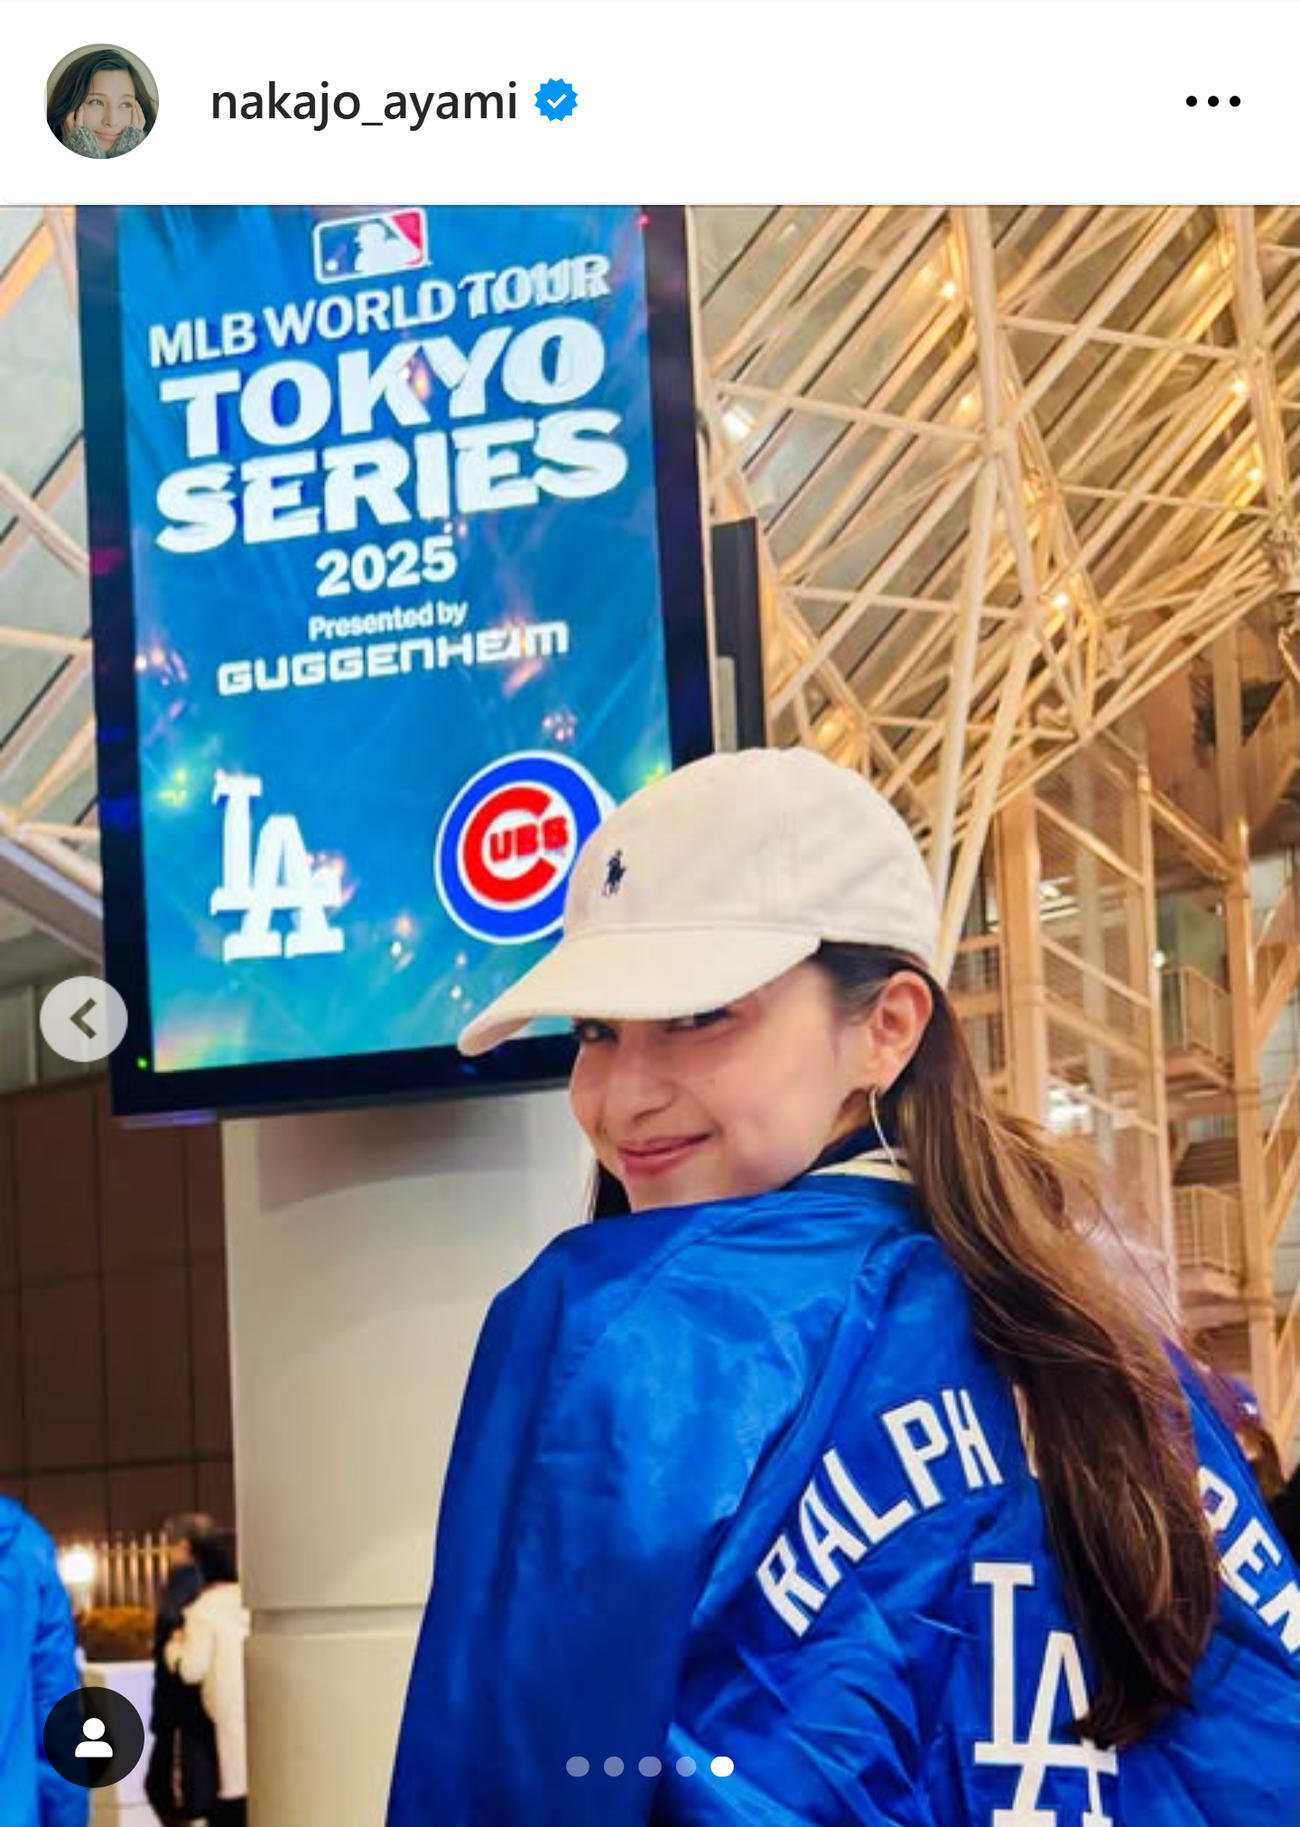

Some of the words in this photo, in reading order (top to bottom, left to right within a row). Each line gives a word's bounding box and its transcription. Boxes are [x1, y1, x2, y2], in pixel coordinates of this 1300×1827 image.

[149, 312, 256, 368] MLB
[264, 279, 455, 348] WORLD
[457, 253, 611, 320] TOUR
[160, 316, 605, 459] TOKYO
[155, 409, 628, 554] SERIES
[308, 602, 434, 642] Presented
[437, 600, 469, 627] by
[315, 536, 457, 598] 2025
[210, 769, 344, 963] LA
[756, 1388, 1003, 1637] RALPH
[971, 1561, 1118, 1827] LA
